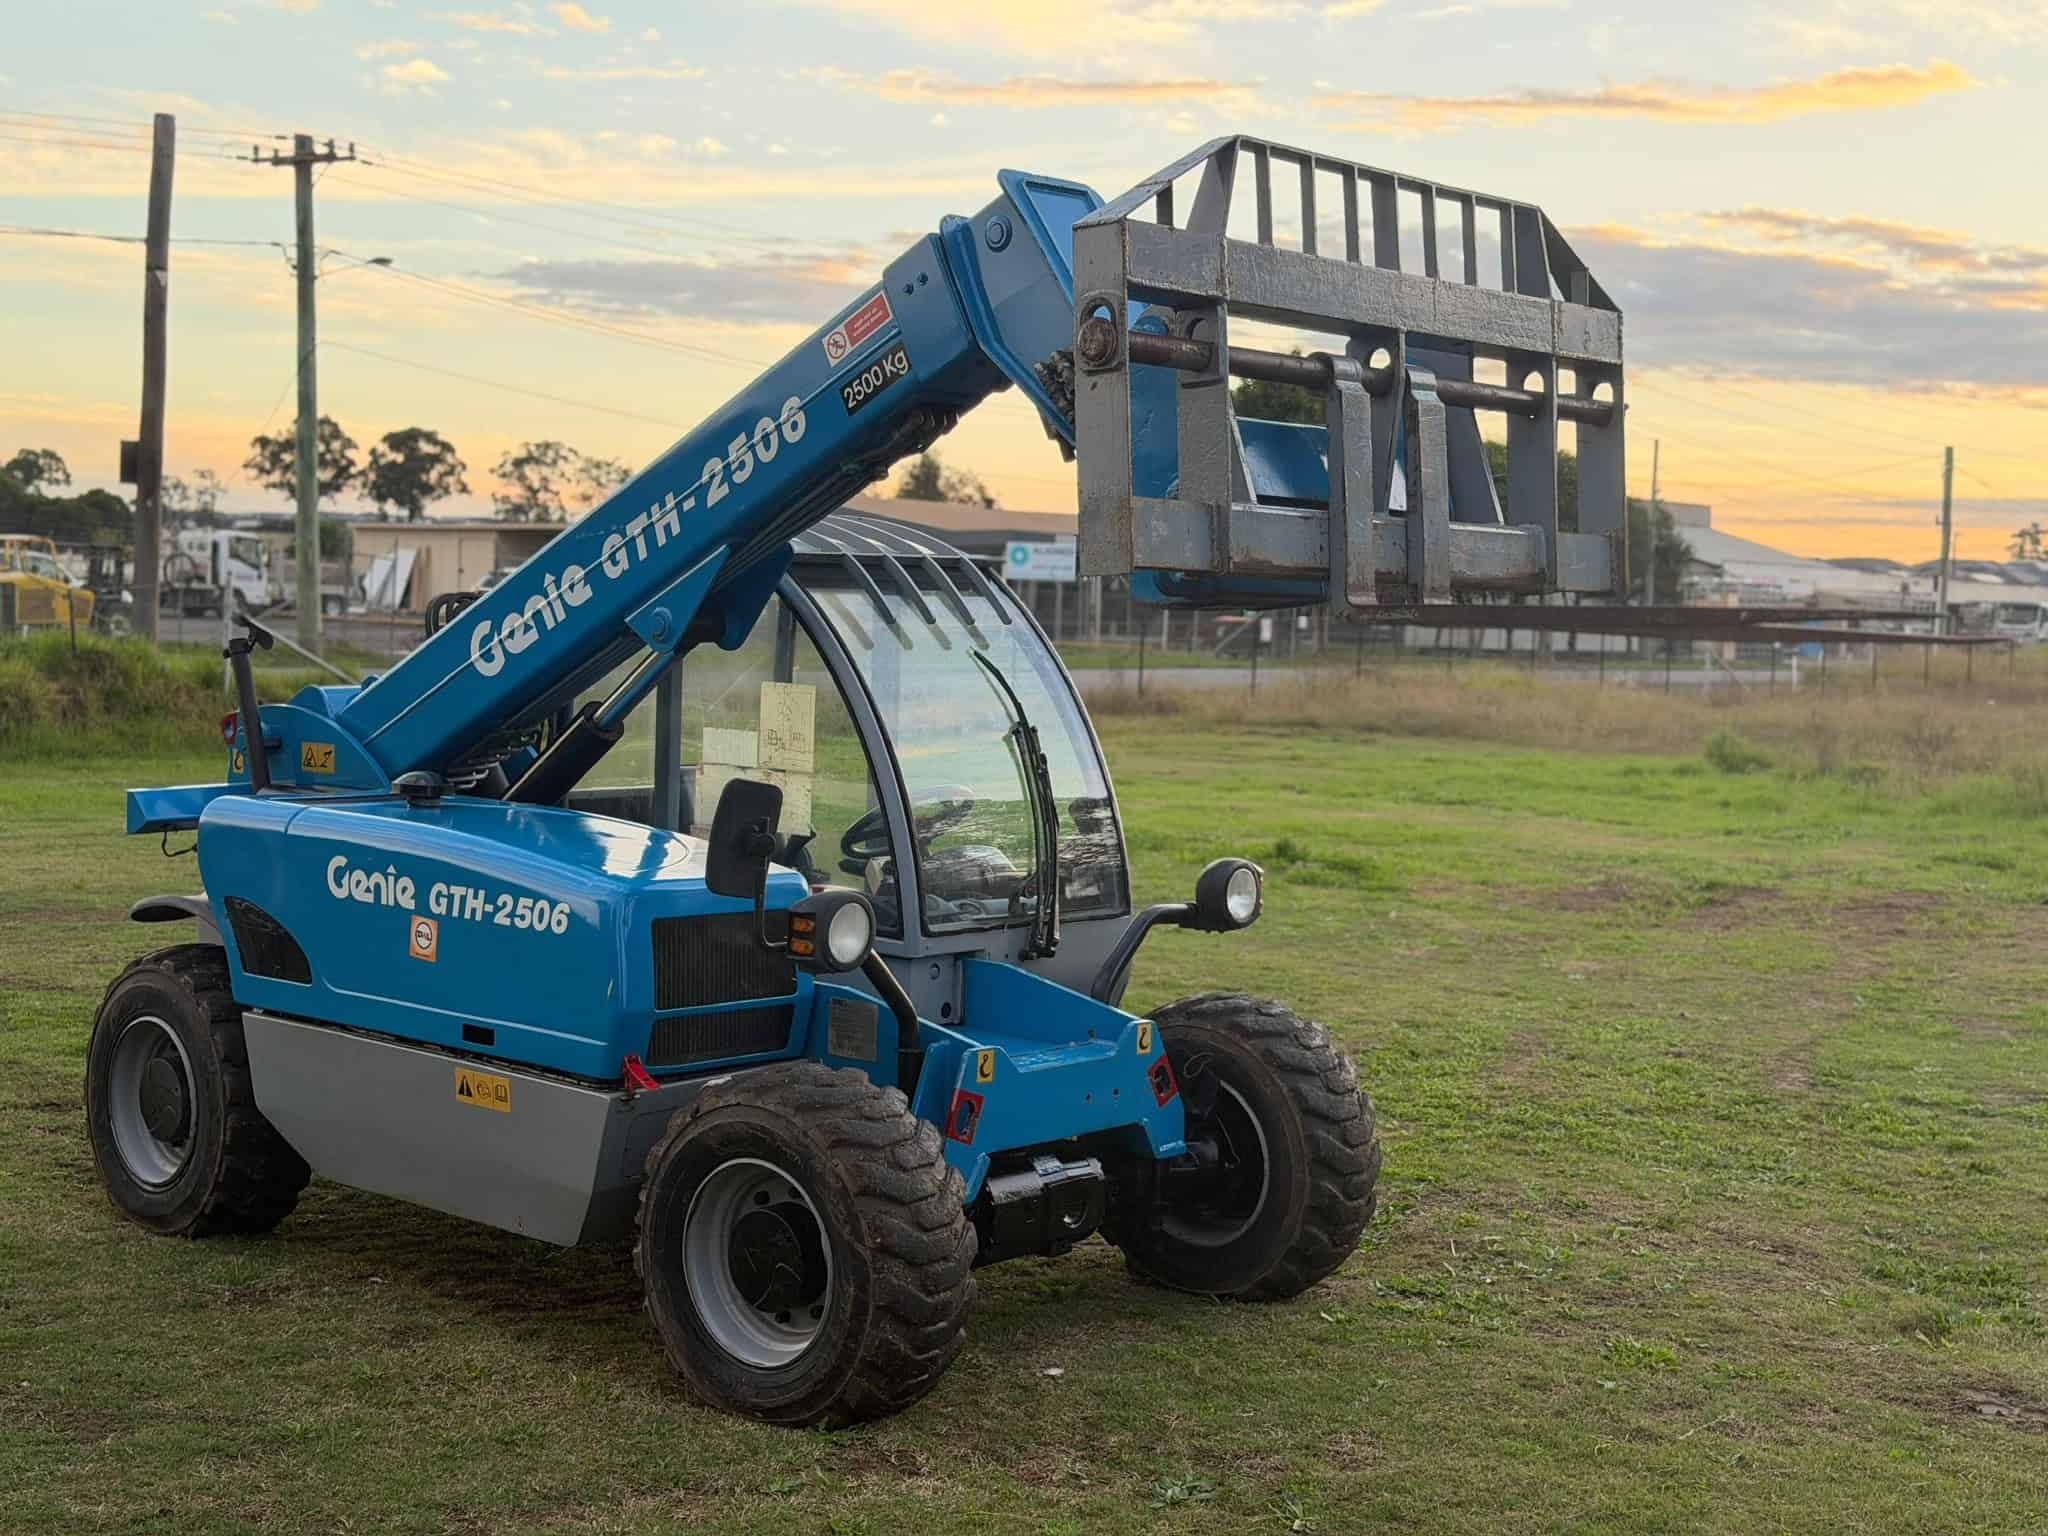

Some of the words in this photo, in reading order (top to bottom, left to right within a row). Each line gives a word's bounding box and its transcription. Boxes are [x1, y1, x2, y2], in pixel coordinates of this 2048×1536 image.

[843, 365, 883, 409] 2500
[882, 350, 909, 377] Kg
[470, 564, 593, 677] Genie
[601, 396, 806, 579] GTH-2506
[327, 855, 416, 910] Genie
[429, 882, 571, 935] GTH-2506
